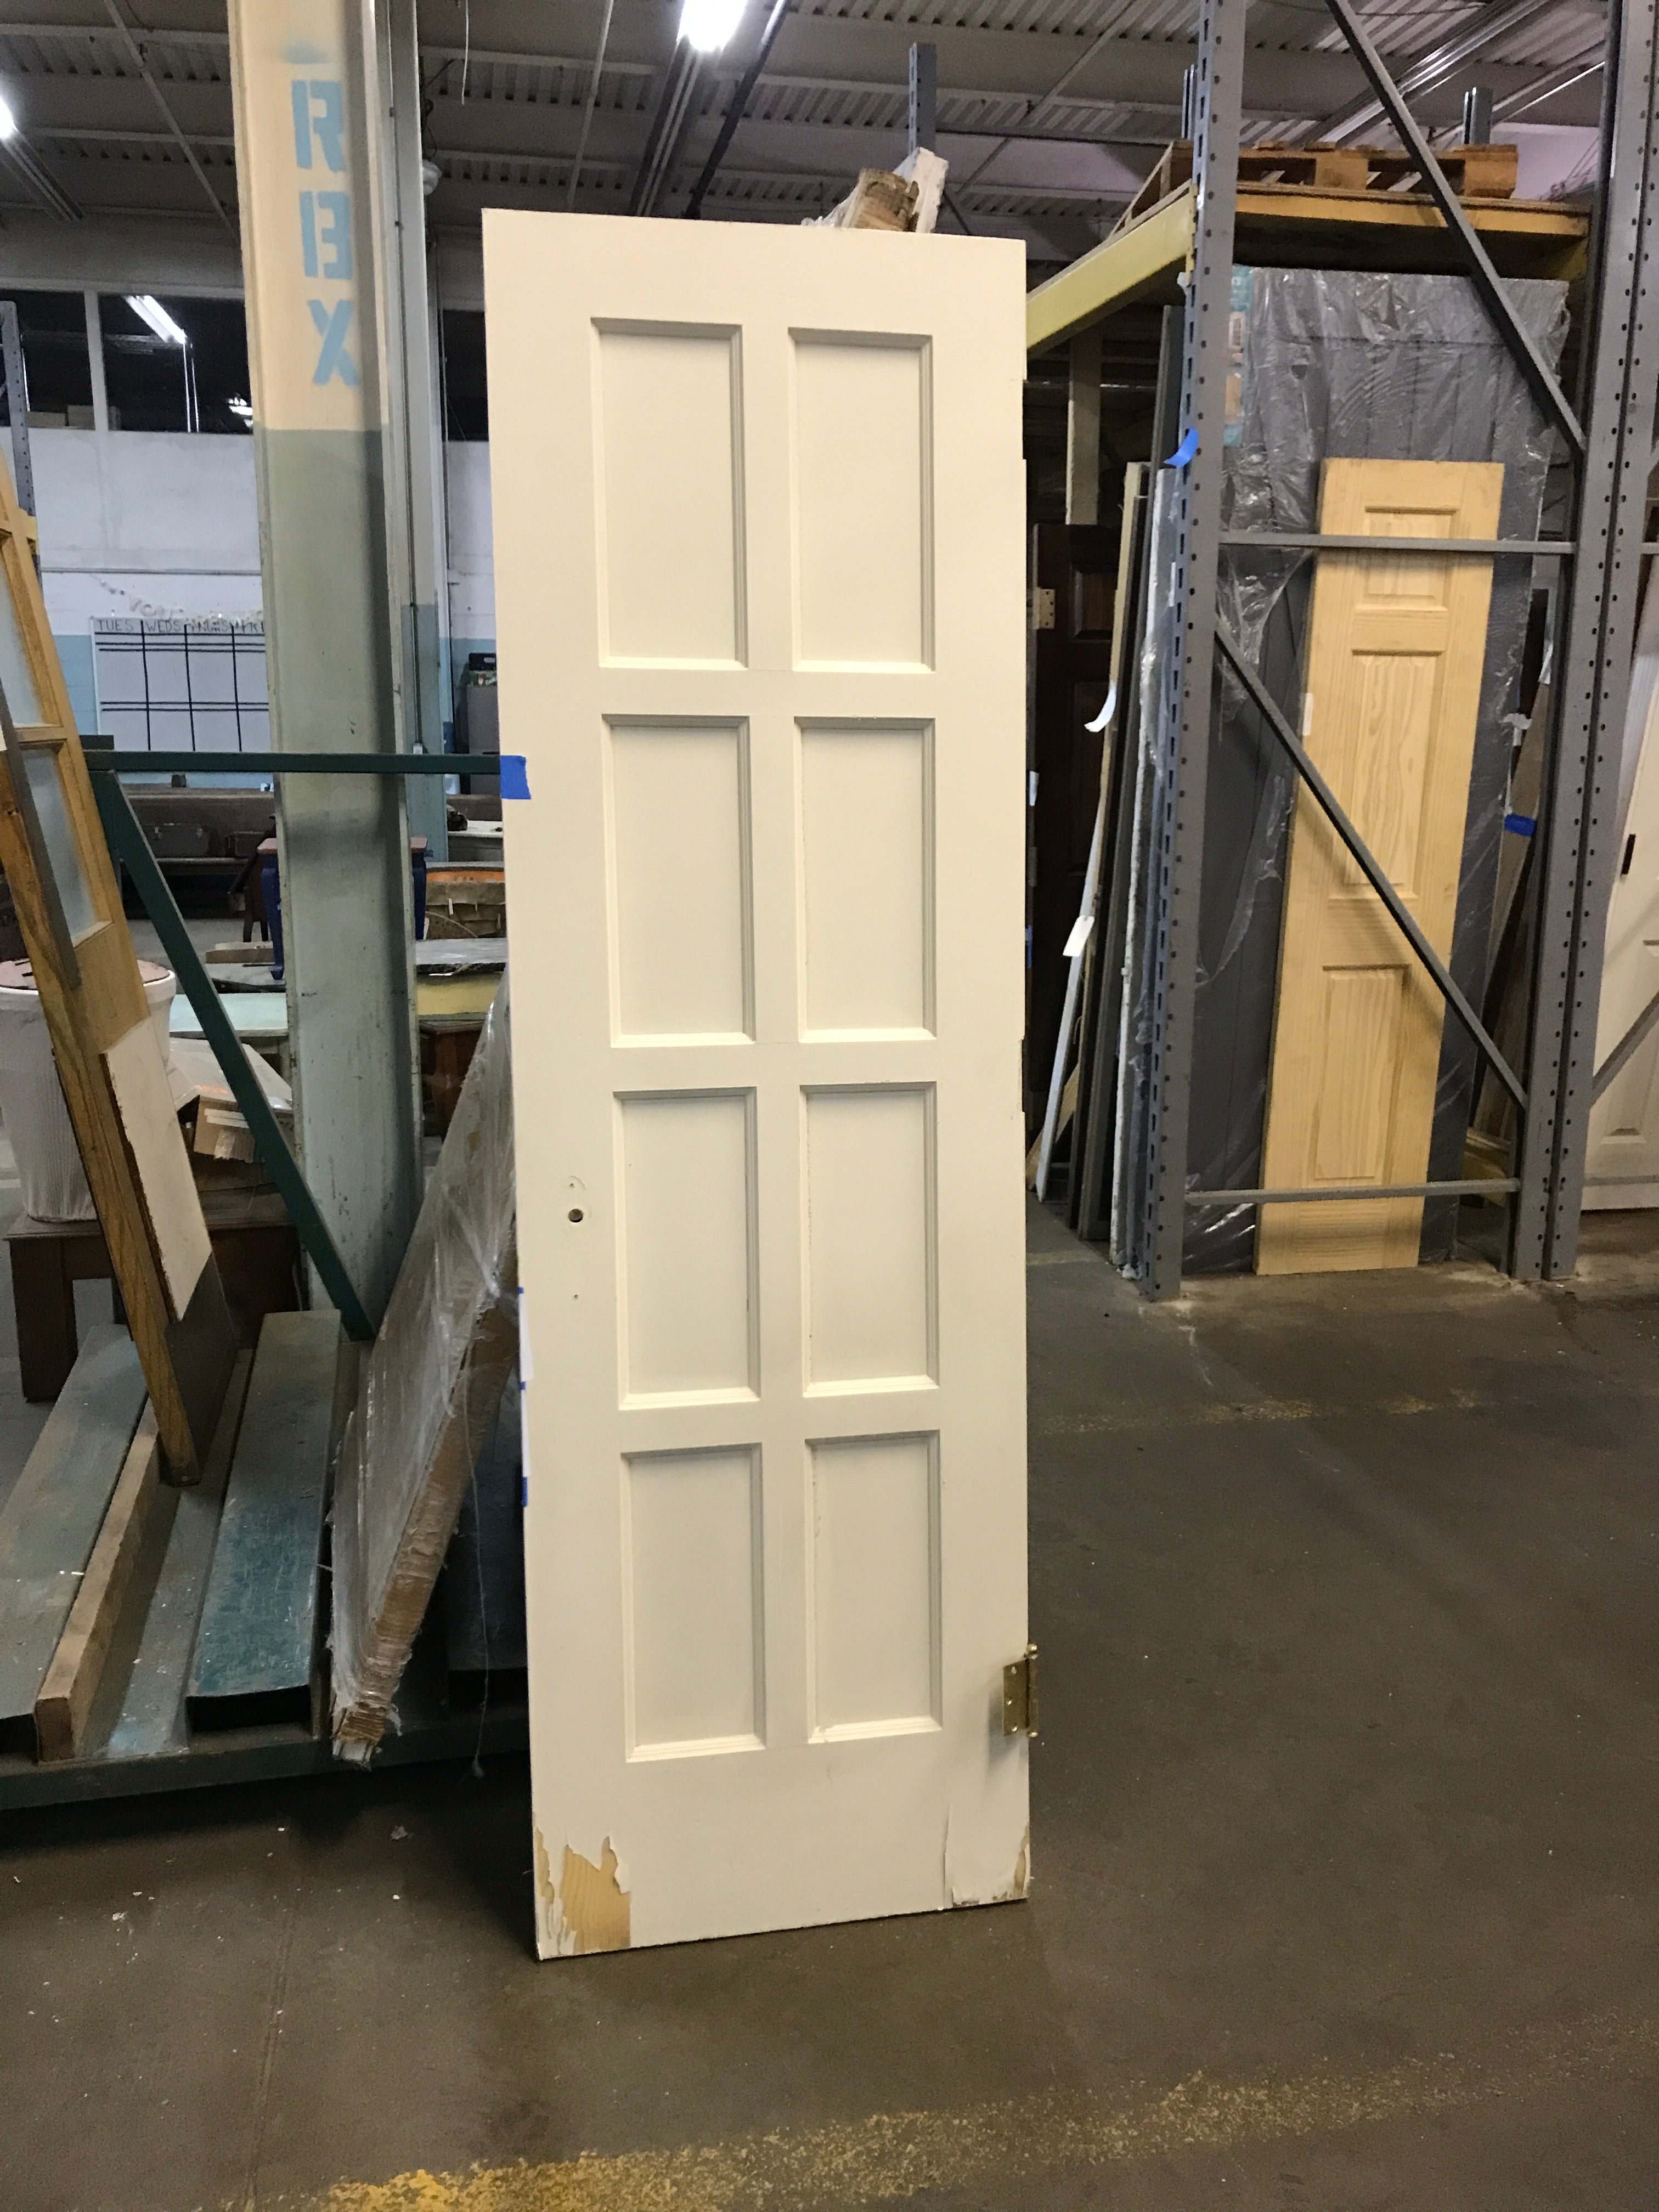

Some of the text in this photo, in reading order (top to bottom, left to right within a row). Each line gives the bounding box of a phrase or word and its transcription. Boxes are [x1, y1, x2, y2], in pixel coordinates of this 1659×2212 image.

[291, 80, 359, 387] RBX
[97, 618, 134, 631] TUES
[145, 619, 182, 632] WEDS
